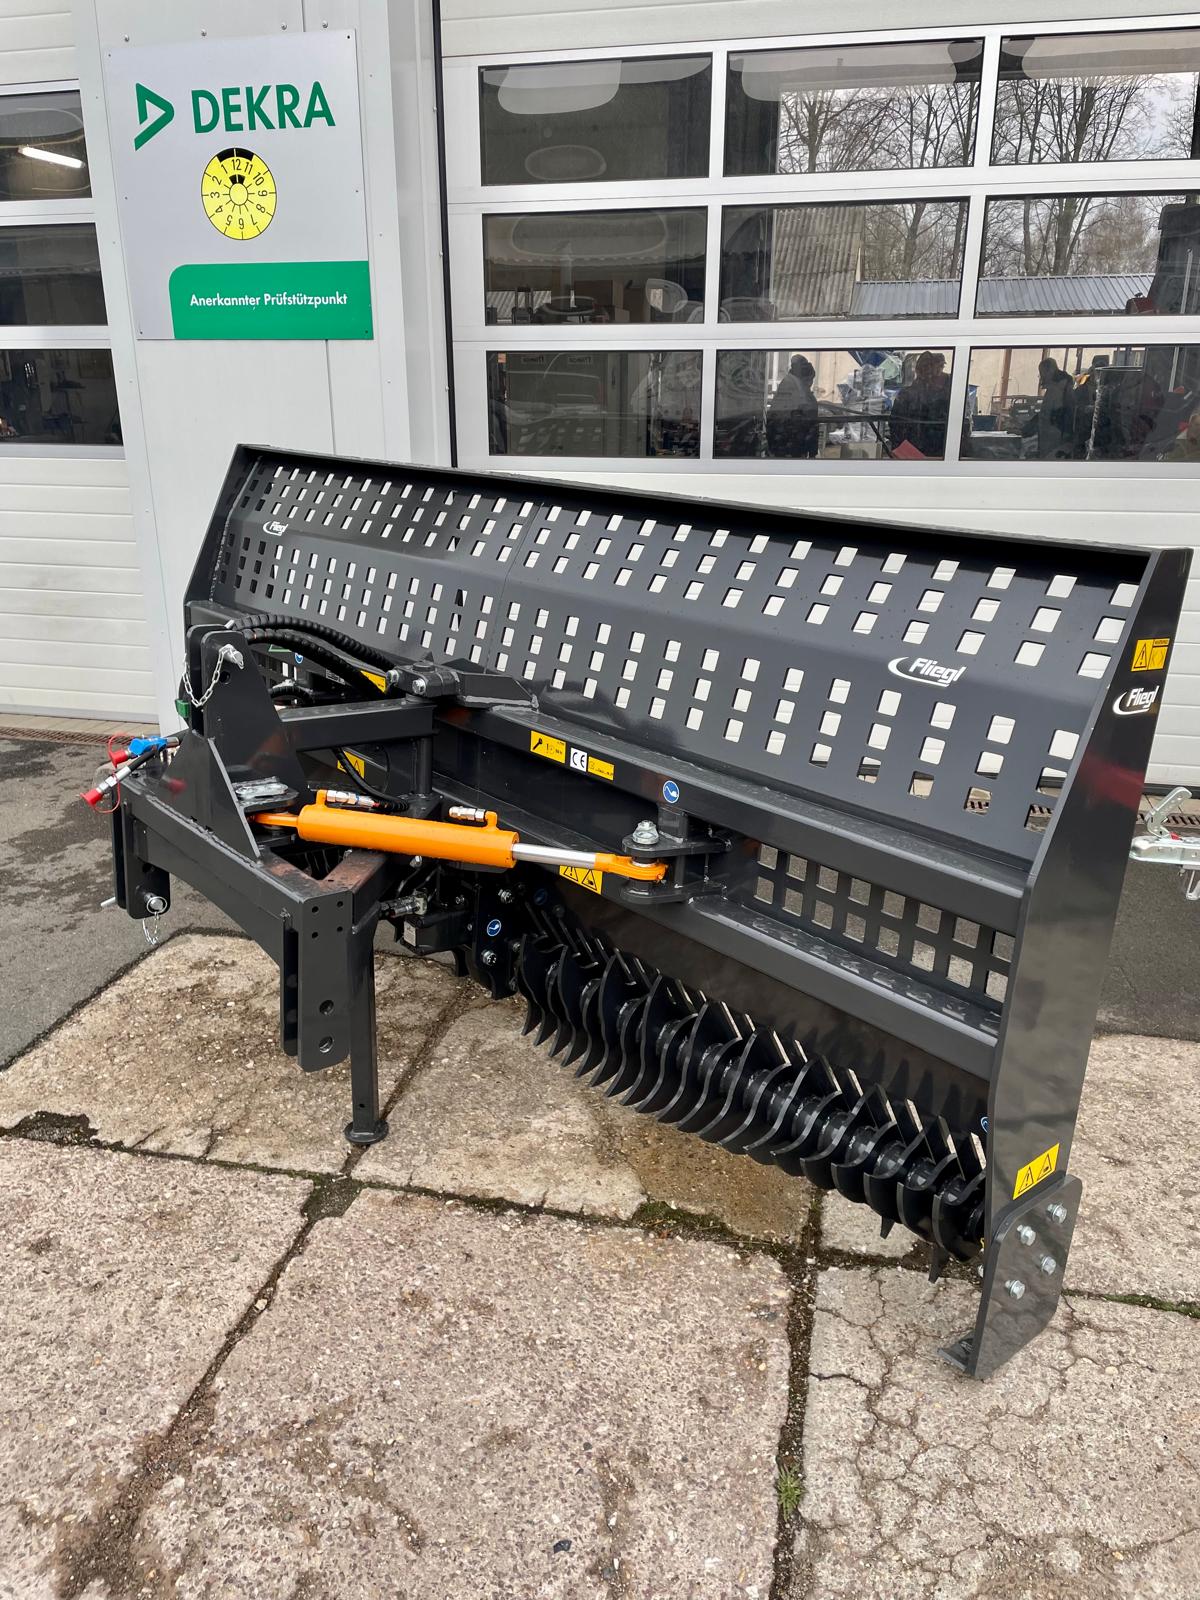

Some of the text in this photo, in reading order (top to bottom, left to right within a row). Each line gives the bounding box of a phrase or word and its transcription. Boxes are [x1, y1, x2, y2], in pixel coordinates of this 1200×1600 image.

[191, 81, 336, 134] DEKRA
[220, 164, 228, 175] 1
[231, 158, 242, 171] 12
[244, 161, 254, 175] 11
[211, 175, 222, 186] 2
[252, 172, 265, 186] 10
[210, 191, 220, 199] 3
[257, 189, 268, 197] 9
[215, 205, 224, 214] 4
[255, 203, 266, 214] 8
[225, 214, 233, 226] 5
[238, 217, 245, 230] 6
[250, 213, 258, 226] 7
[190, 291, 348, 309] Anerkannter Prüfstützpunkt
[908, 657, 967, 683] Fliegl
[1126, 685, 1160, 708] Fliegl
